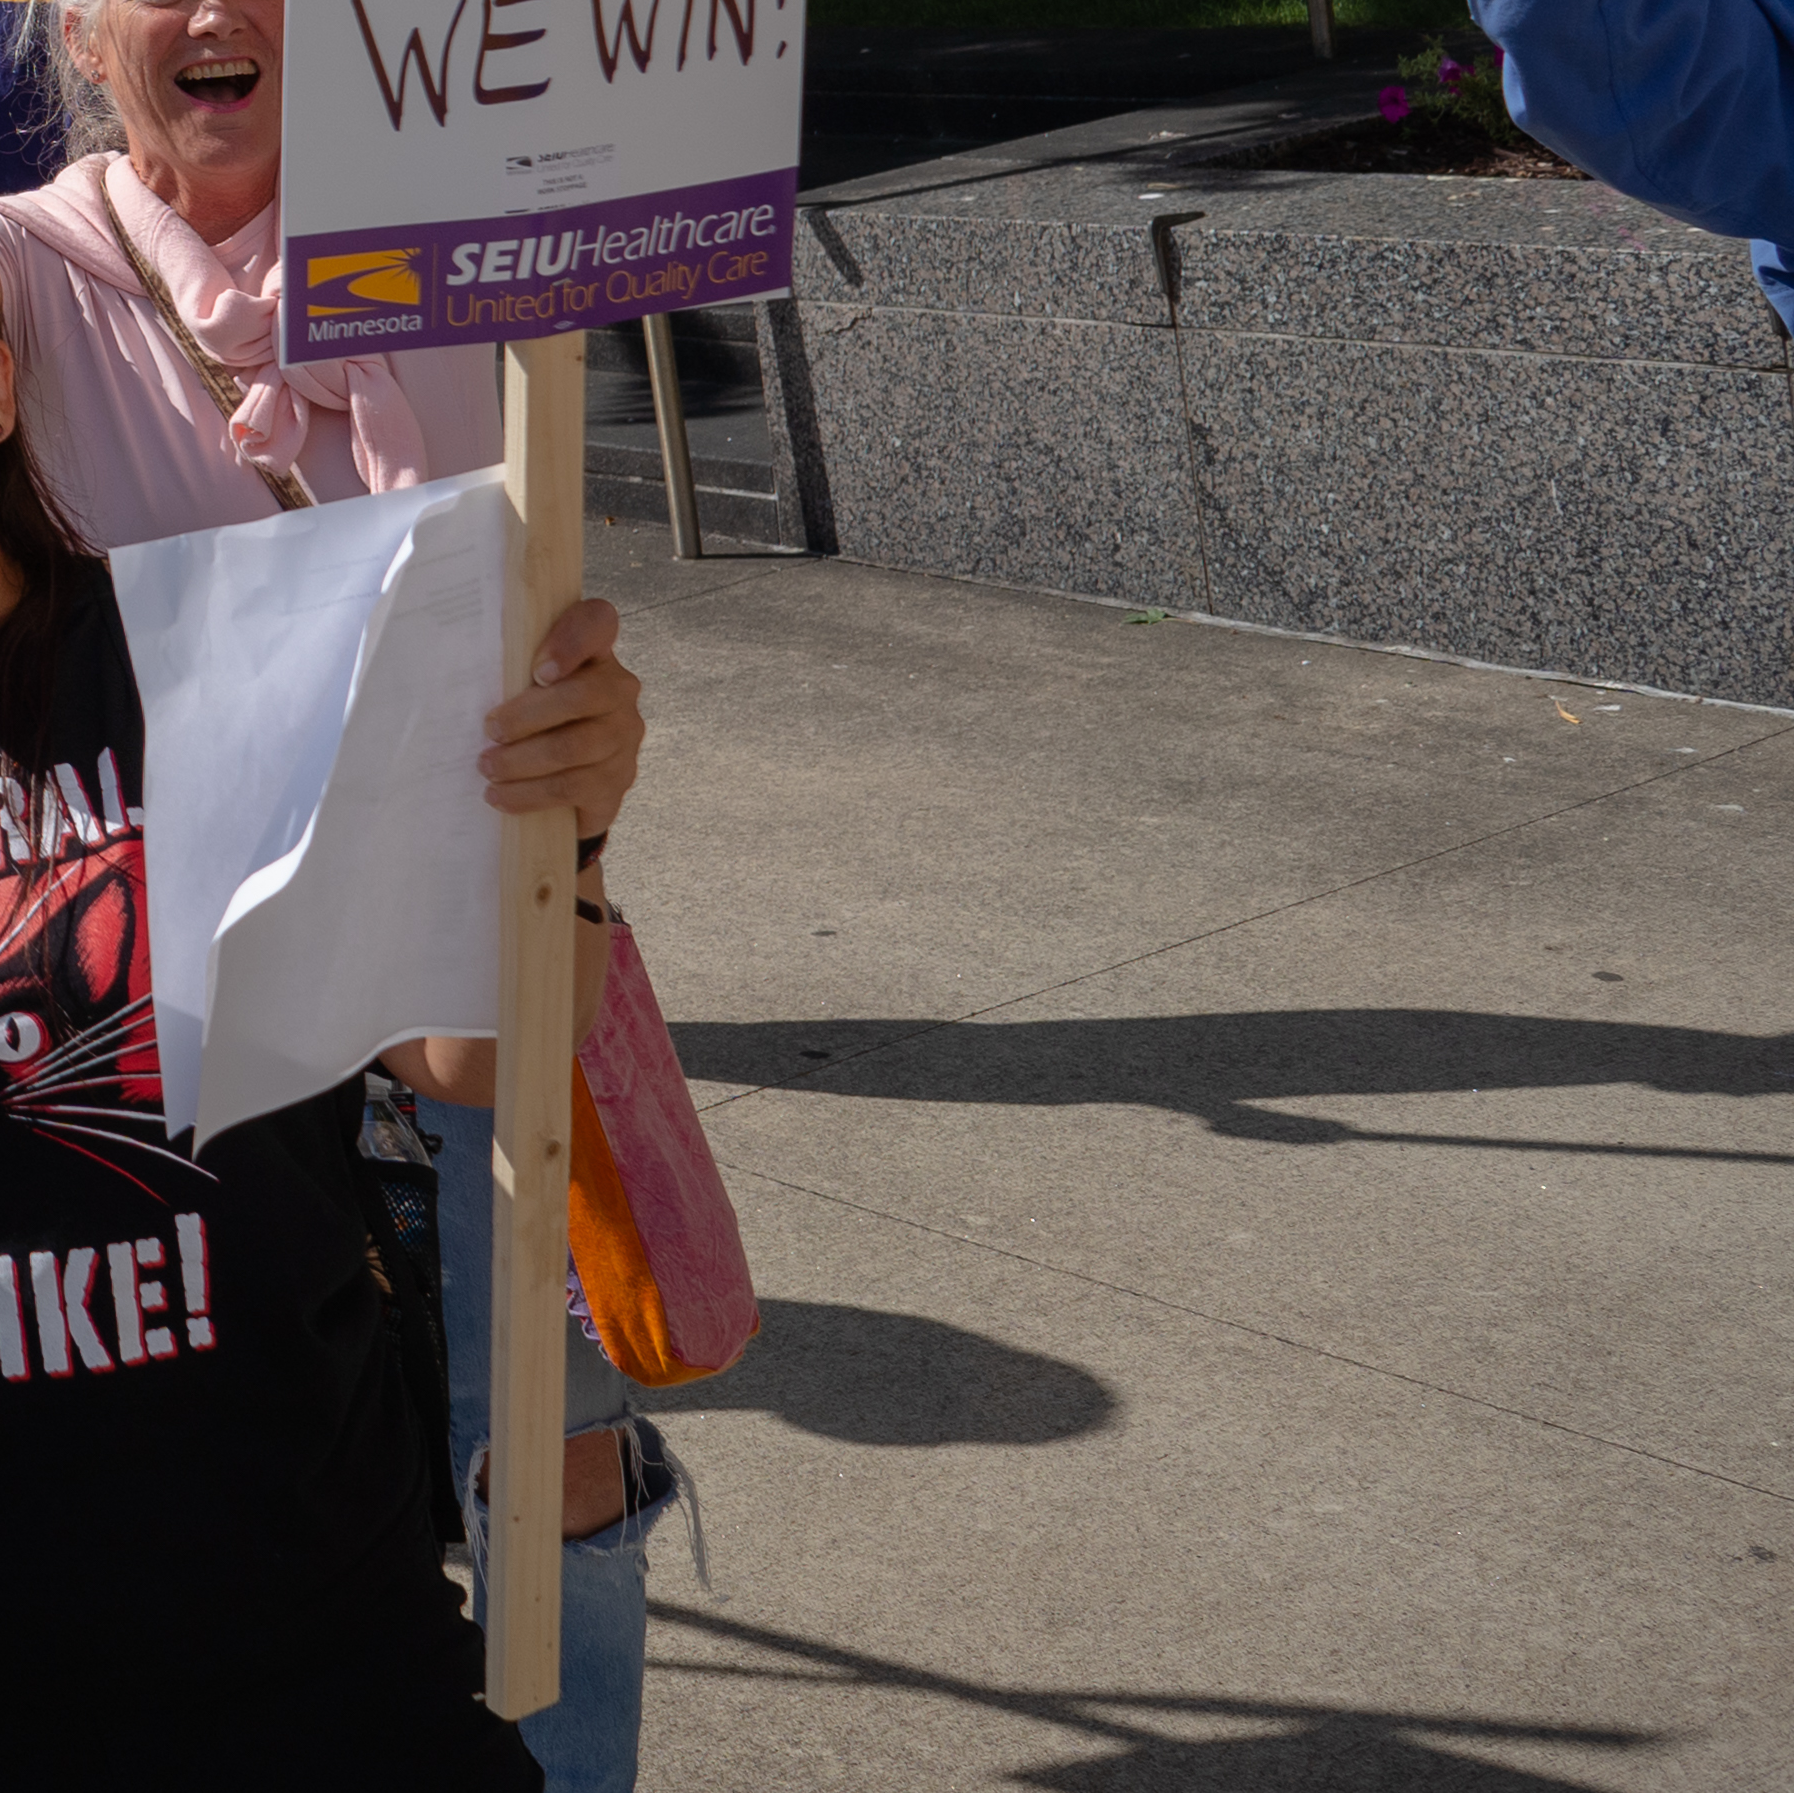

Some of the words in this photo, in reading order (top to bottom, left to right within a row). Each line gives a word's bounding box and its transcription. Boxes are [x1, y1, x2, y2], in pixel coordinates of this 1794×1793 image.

[446, 204, 774, 286] SEIUHealthcare
[447, 284, 556, 326] United
[562, 278, 600, 315] for
[606, 263, 701, 304] Quality
[707, 248, 768, 286] Care
[307, 314, 423, 342] Minnesota
